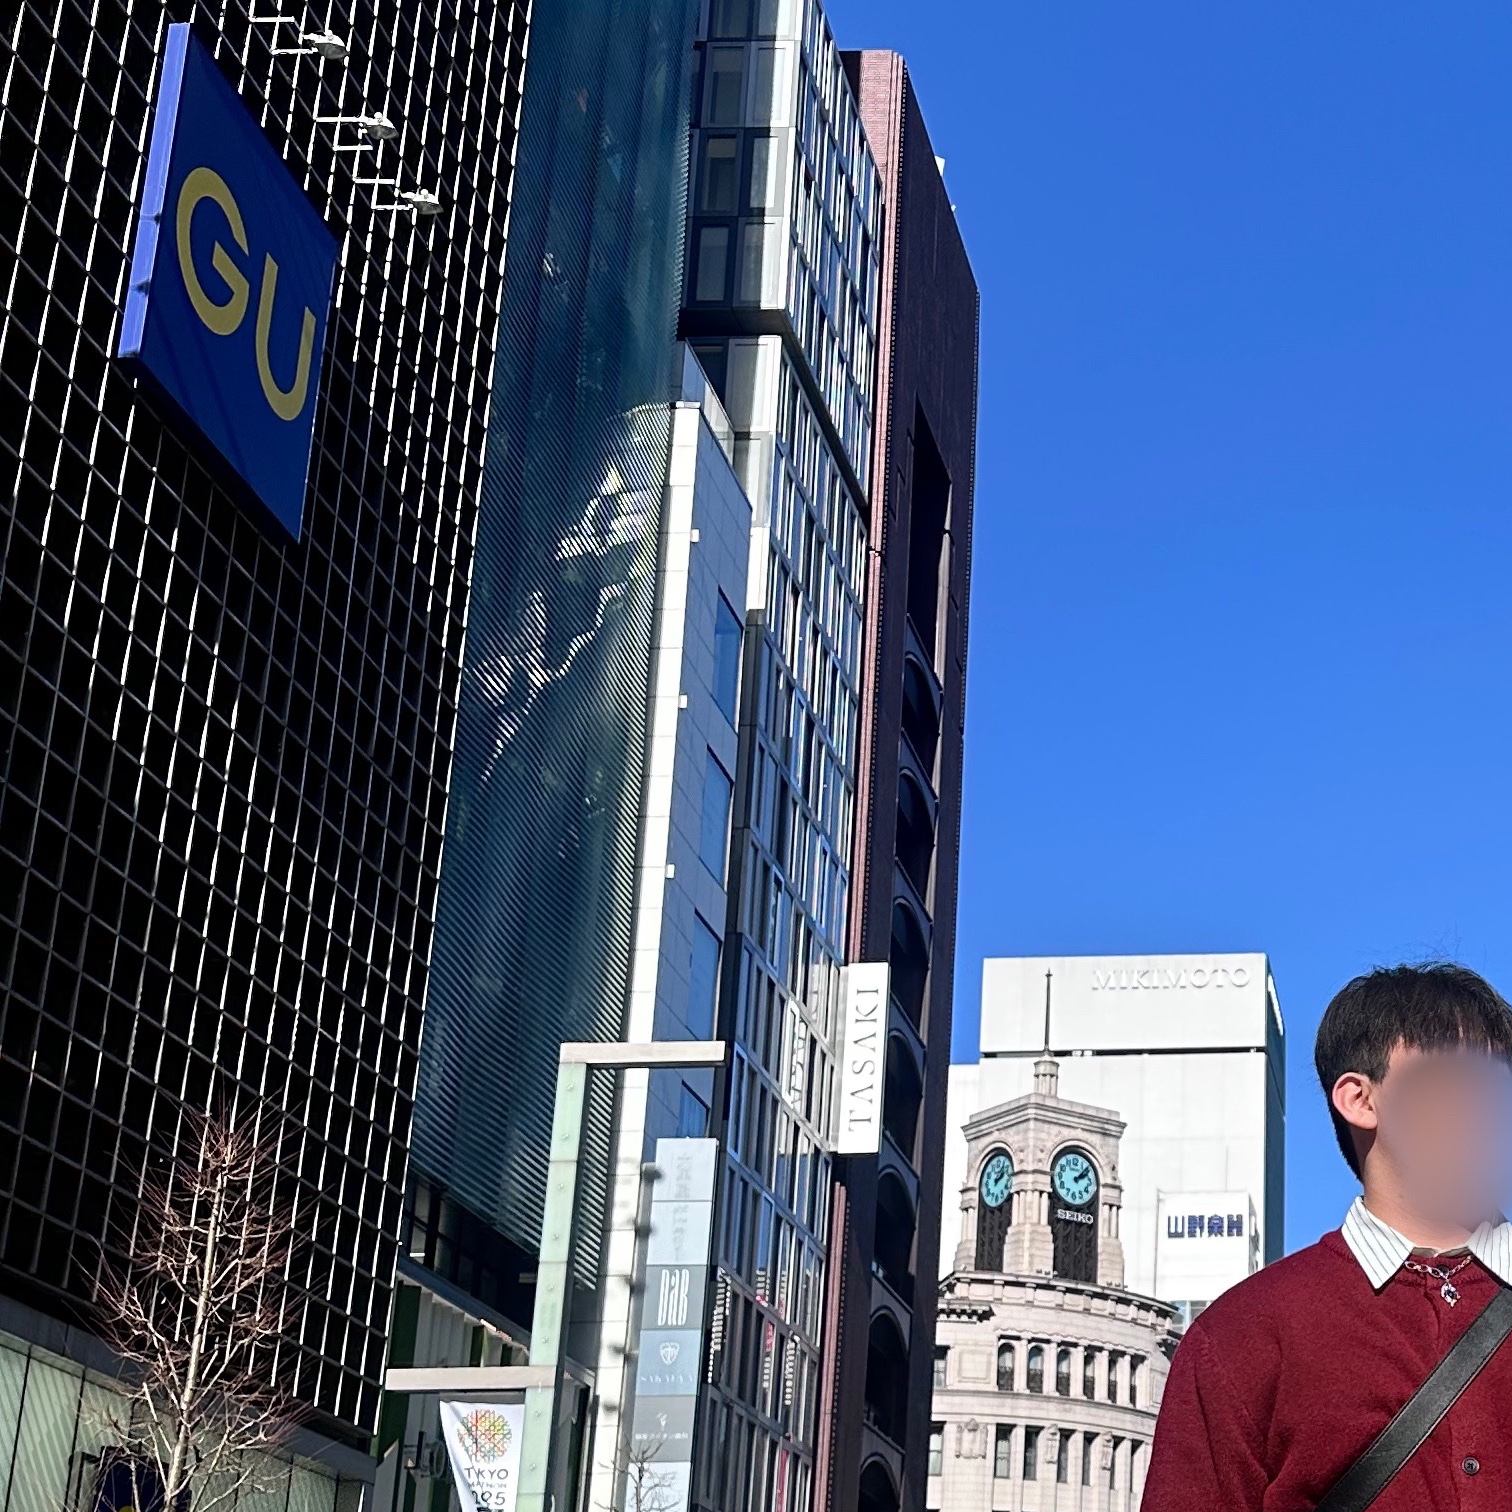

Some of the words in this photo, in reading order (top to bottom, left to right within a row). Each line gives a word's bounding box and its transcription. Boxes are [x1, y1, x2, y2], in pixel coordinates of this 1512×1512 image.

[176, 167, 316, 421] GU
[1092, 968, 1251, 990] MIKIMOTO
[848, 988, 879, 1132] TASAKI
[1057, 1208, 1094, 1225] SEIKO
